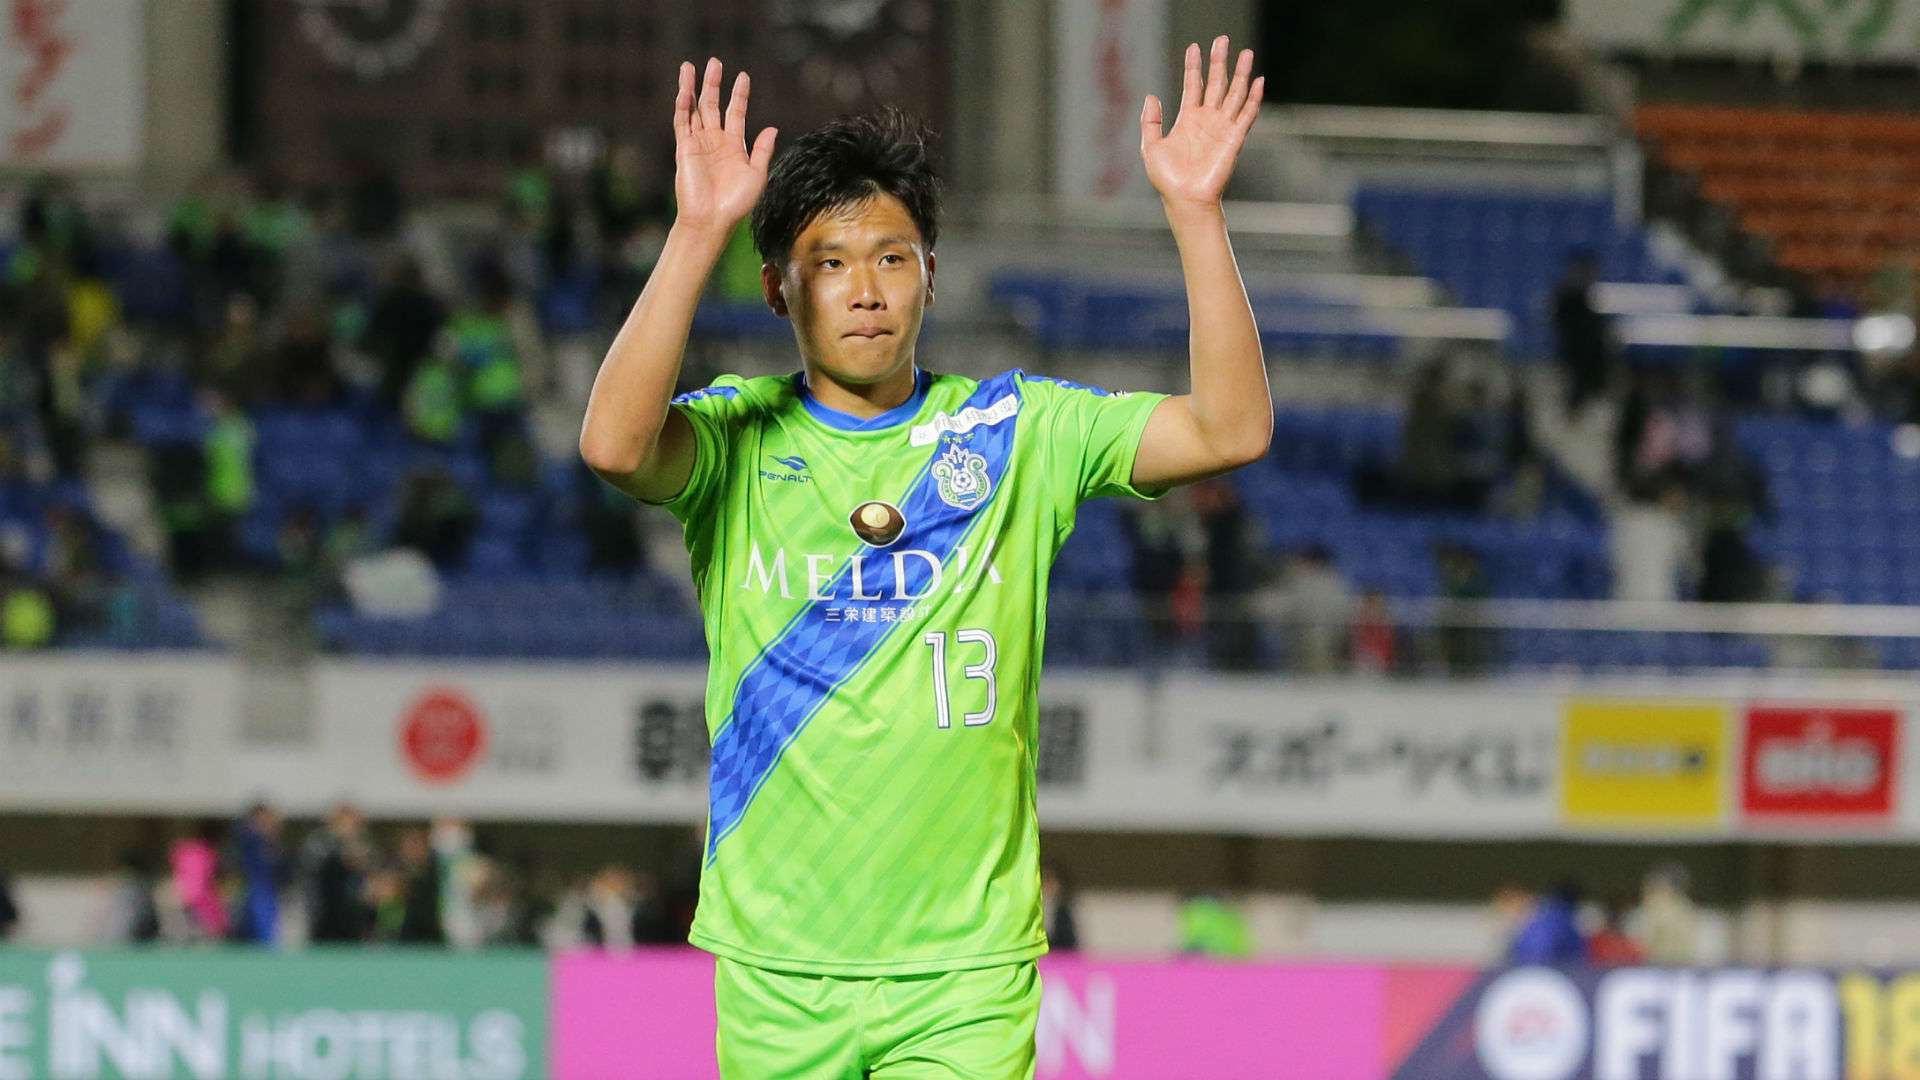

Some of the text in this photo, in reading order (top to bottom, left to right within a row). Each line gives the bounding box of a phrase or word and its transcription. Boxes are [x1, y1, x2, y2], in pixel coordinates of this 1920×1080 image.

[758, 470, 814, 483] PENALT
[925, 628, 997, 729] 13
[240, 1009, 526, 1080] HOTELS
[1597, 966, 1840, 1080] FIFA
